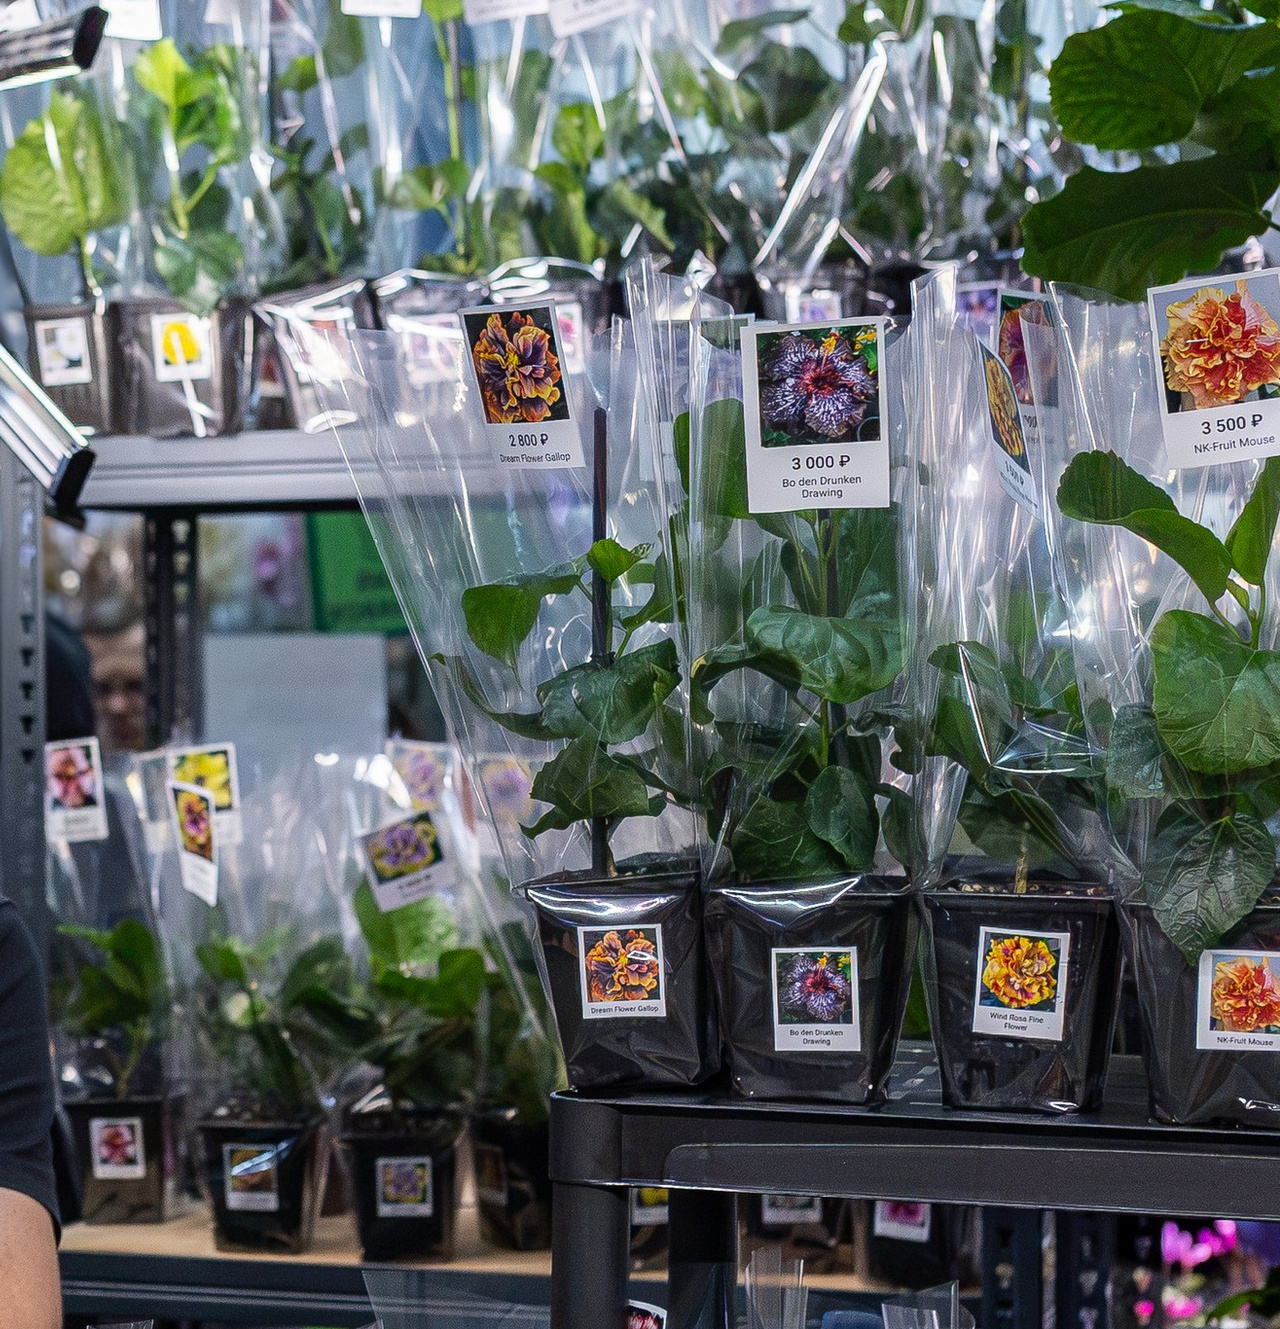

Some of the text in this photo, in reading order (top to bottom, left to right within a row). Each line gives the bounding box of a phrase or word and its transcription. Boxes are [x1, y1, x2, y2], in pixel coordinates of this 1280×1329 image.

[1200, 421, 1211, 435] 3
[1216, 416, 1246, 433] 500
[510, 434, 517, 447] 2
[518, 434, 538, 446] 800
[1194, 435, 1275, 454] NK-Fruit Mouse
[499, 452, 570, 464] Dream Flower Gallop
[791, 457, 802, 470] 3
[805, 456, 834, 469] 000
[782, 475, 862, 488] Bo den Drunken
[802, 488, 843, 499] Drawing
[590, 1005, 613, 1014] Dream
[638, 1004, 659, 1014] Gallop
